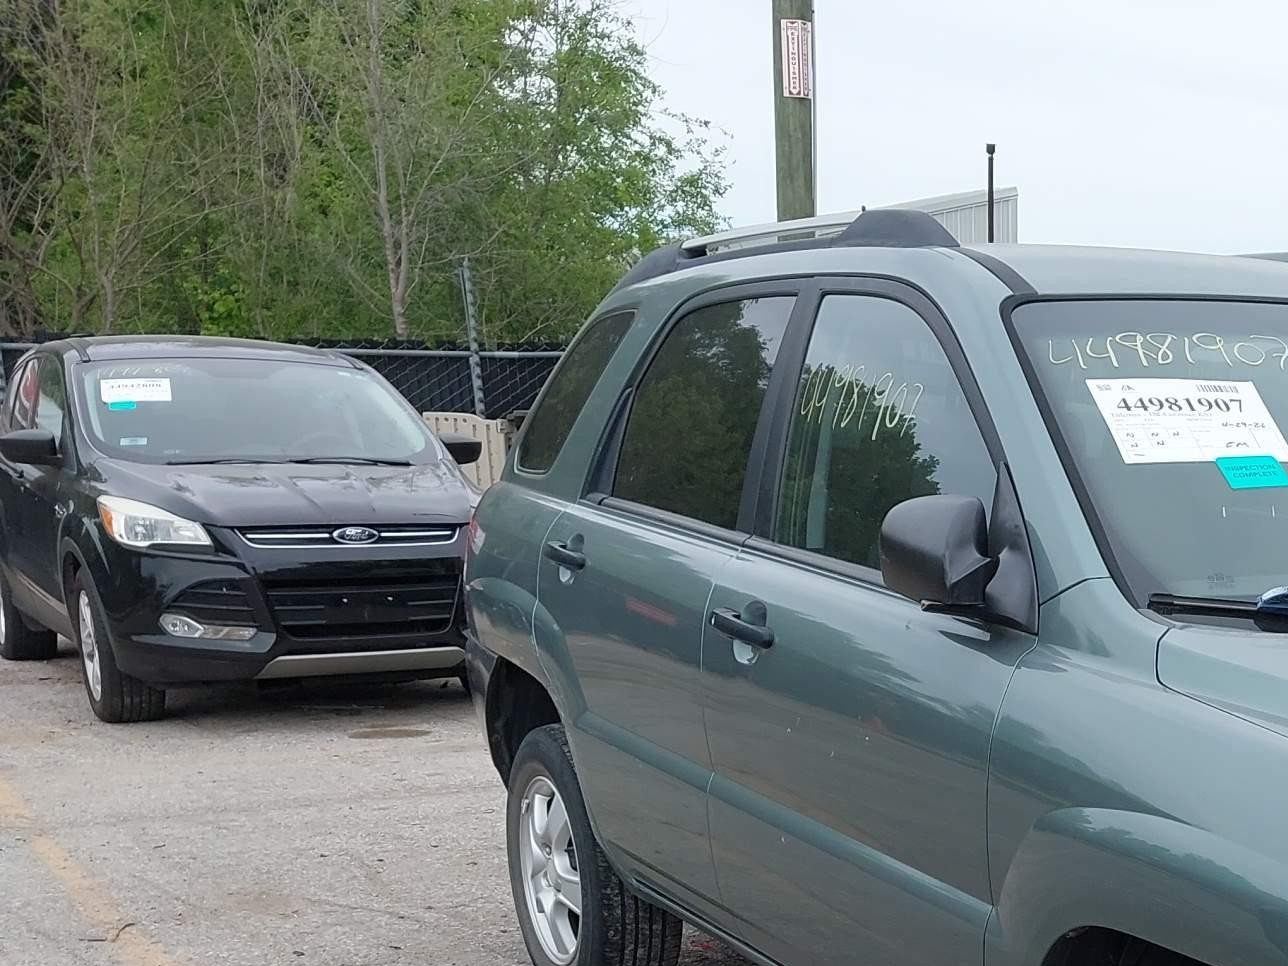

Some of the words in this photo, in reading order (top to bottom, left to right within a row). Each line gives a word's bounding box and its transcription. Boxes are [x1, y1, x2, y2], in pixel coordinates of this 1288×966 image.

[1049, 332, 1288, 369] 44981907
[801, 365, 923, 440] 44981907
[1117, 397, 1242, 412] 44981907
[1224, 464, 1277, 472] INSPECTION
